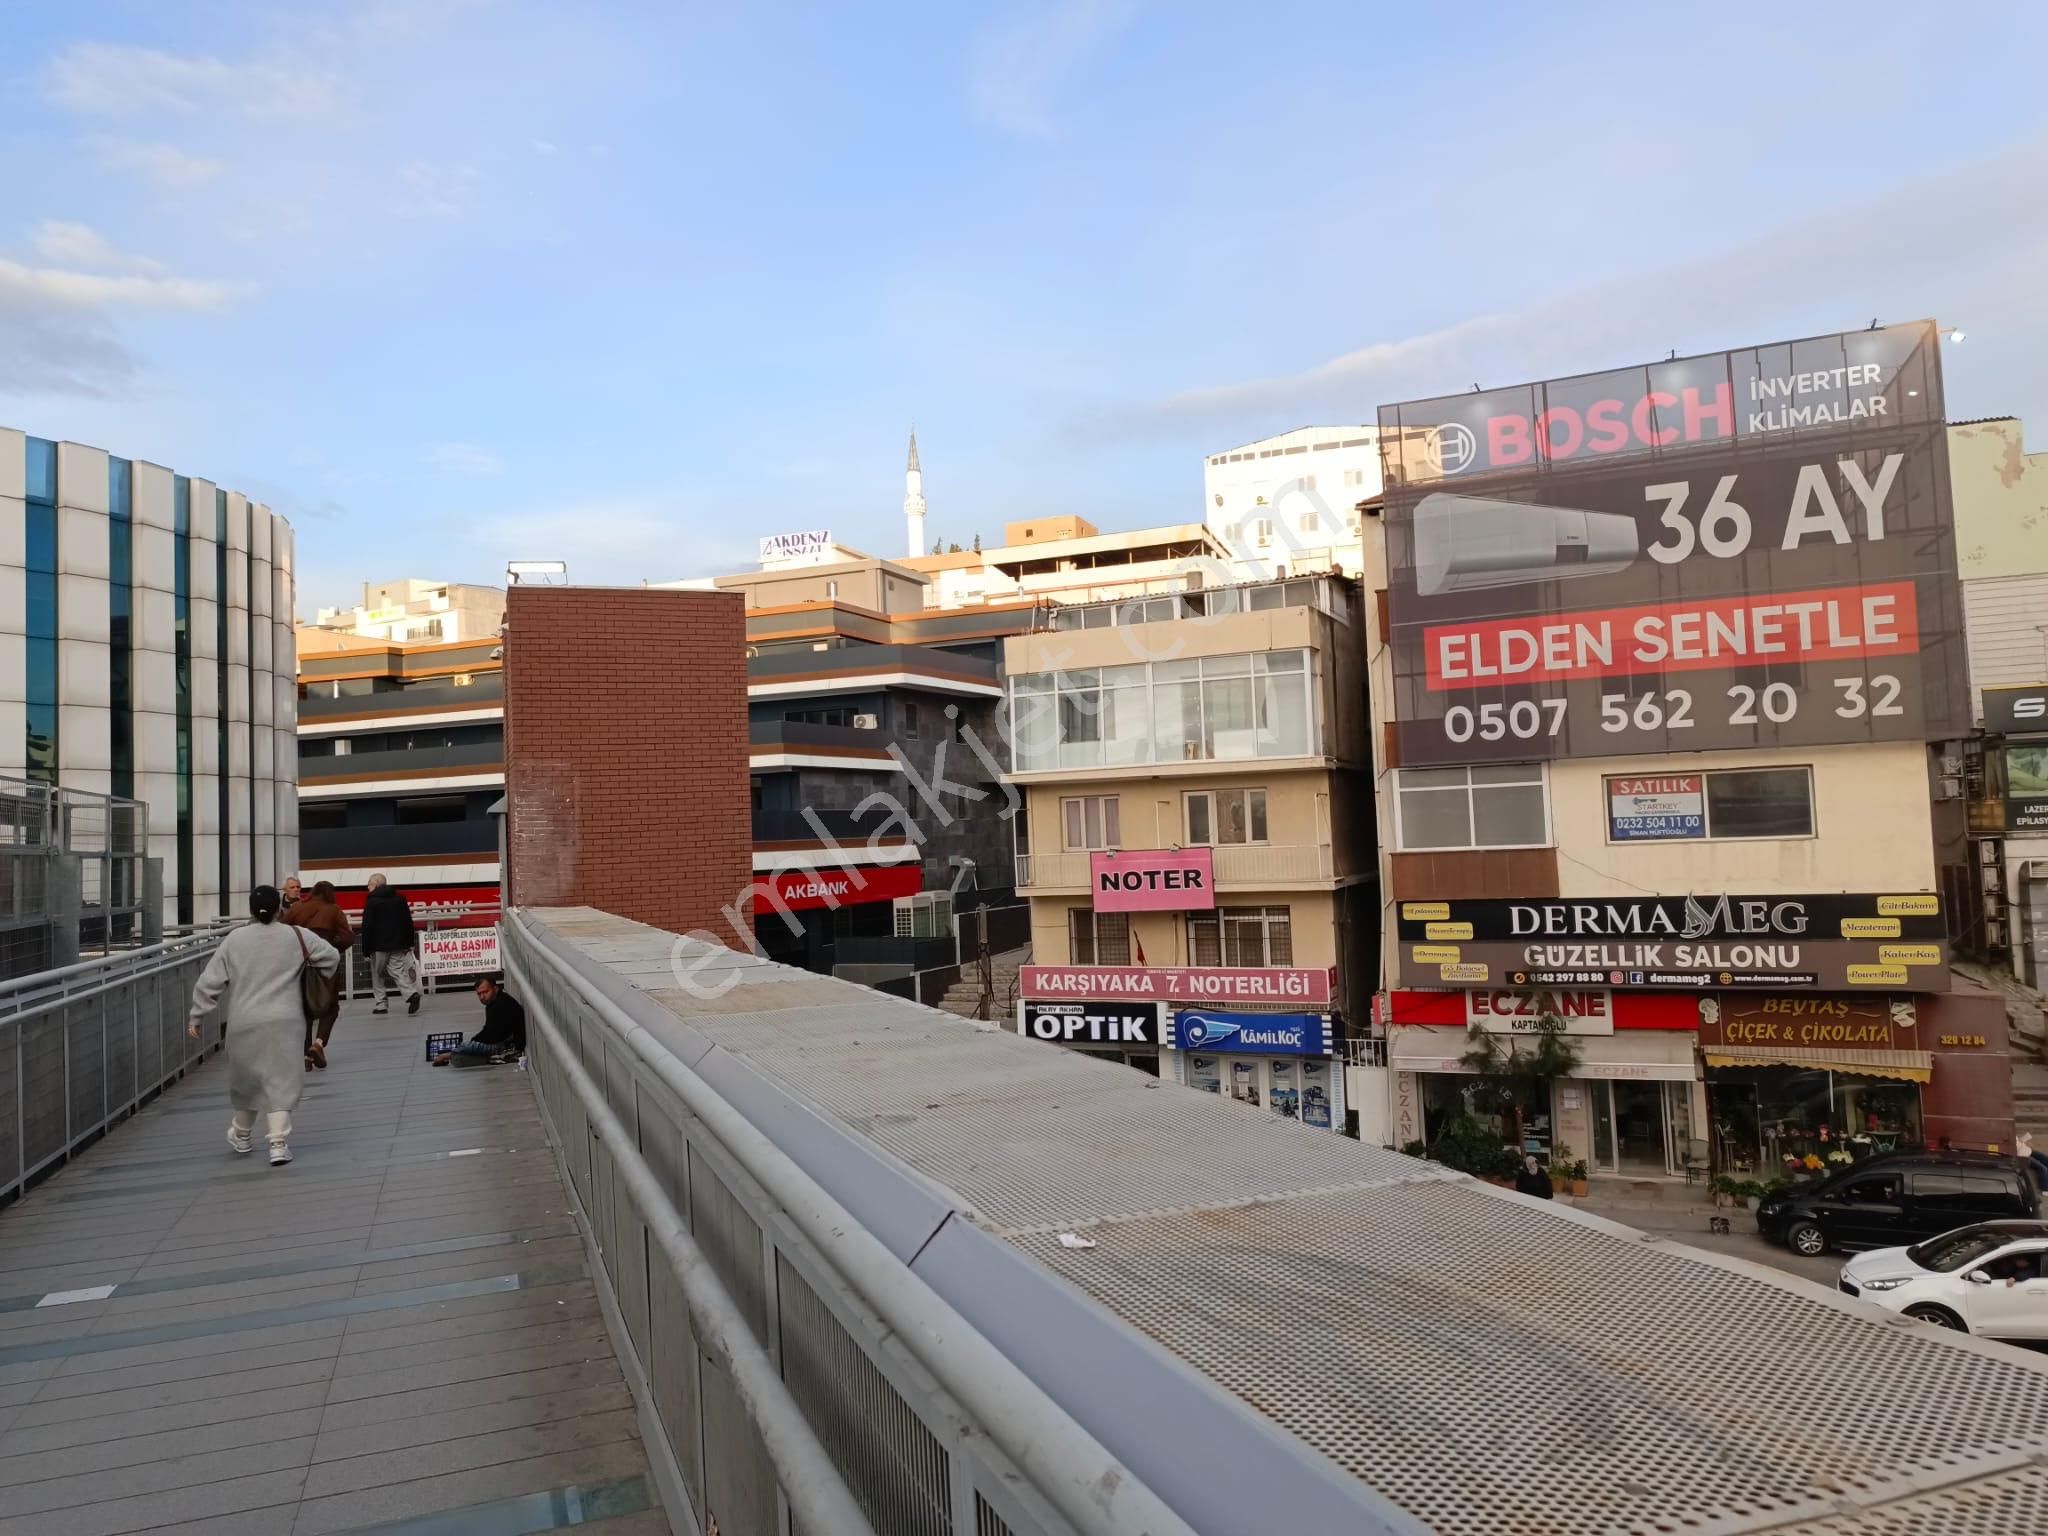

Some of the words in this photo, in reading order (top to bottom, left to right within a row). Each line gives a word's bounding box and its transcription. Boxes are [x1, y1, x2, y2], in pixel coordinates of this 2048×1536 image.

[1749, 364, 1881, 401] İNVERTER
[1486, 382, 1734, 465] BOSCH
[1748, 396, 1889, 433] KLİMALAR
[1645, 474, 1751, 564] 36
[1781, 453, 1904, 552] AY
[1439, 621, 1615, 680] ELDEN
[1633, 596, 1899, 662] SENETLE
[1444, 698, 1568, 743] 0507
[1600, 689, 1695, 733] 562
[1727, 682, 1798, 725] 20
[1833, 675, 1903, 718] 32
[1620, 779, 1692, 793] SATILIK
[1616, 818, 1642, 829] 0232
[1646, 817, 1666, 828] 504
[1670, 817, 1682, 828] 11
[1685, 816, 1700, 827] 00
[785, 881, 848, 899] AKBANK
[1100, 869, 1205, 891] NOTER
[424, 941, 458, 953] PLAKA
[462, 939, 496, 951] BASIMI
[1675, 945, 1801, 968] SALONU
[1035, 974, 1155, 996] KARŞIYAKA
[1166, 975, 1180, 994] 7.
[1189, 972, 1311, 996] NOTERLİĞİ
[1530, 973, 1555, 983] 0542
[1556, 973, 1574, 983] 297
[1649, 973, 1711, 986] dermameg2
[1472, 990, 1605, 1017] ECZANE
[1726, 1023, 1779, 1043] ÇİÇEK
[1783, 1025, 1796, 1041] &
[1800, 1022, 1891, 1045] ÇİKOLATA
[1399, 1071, 1412, 1144] ECZAN
